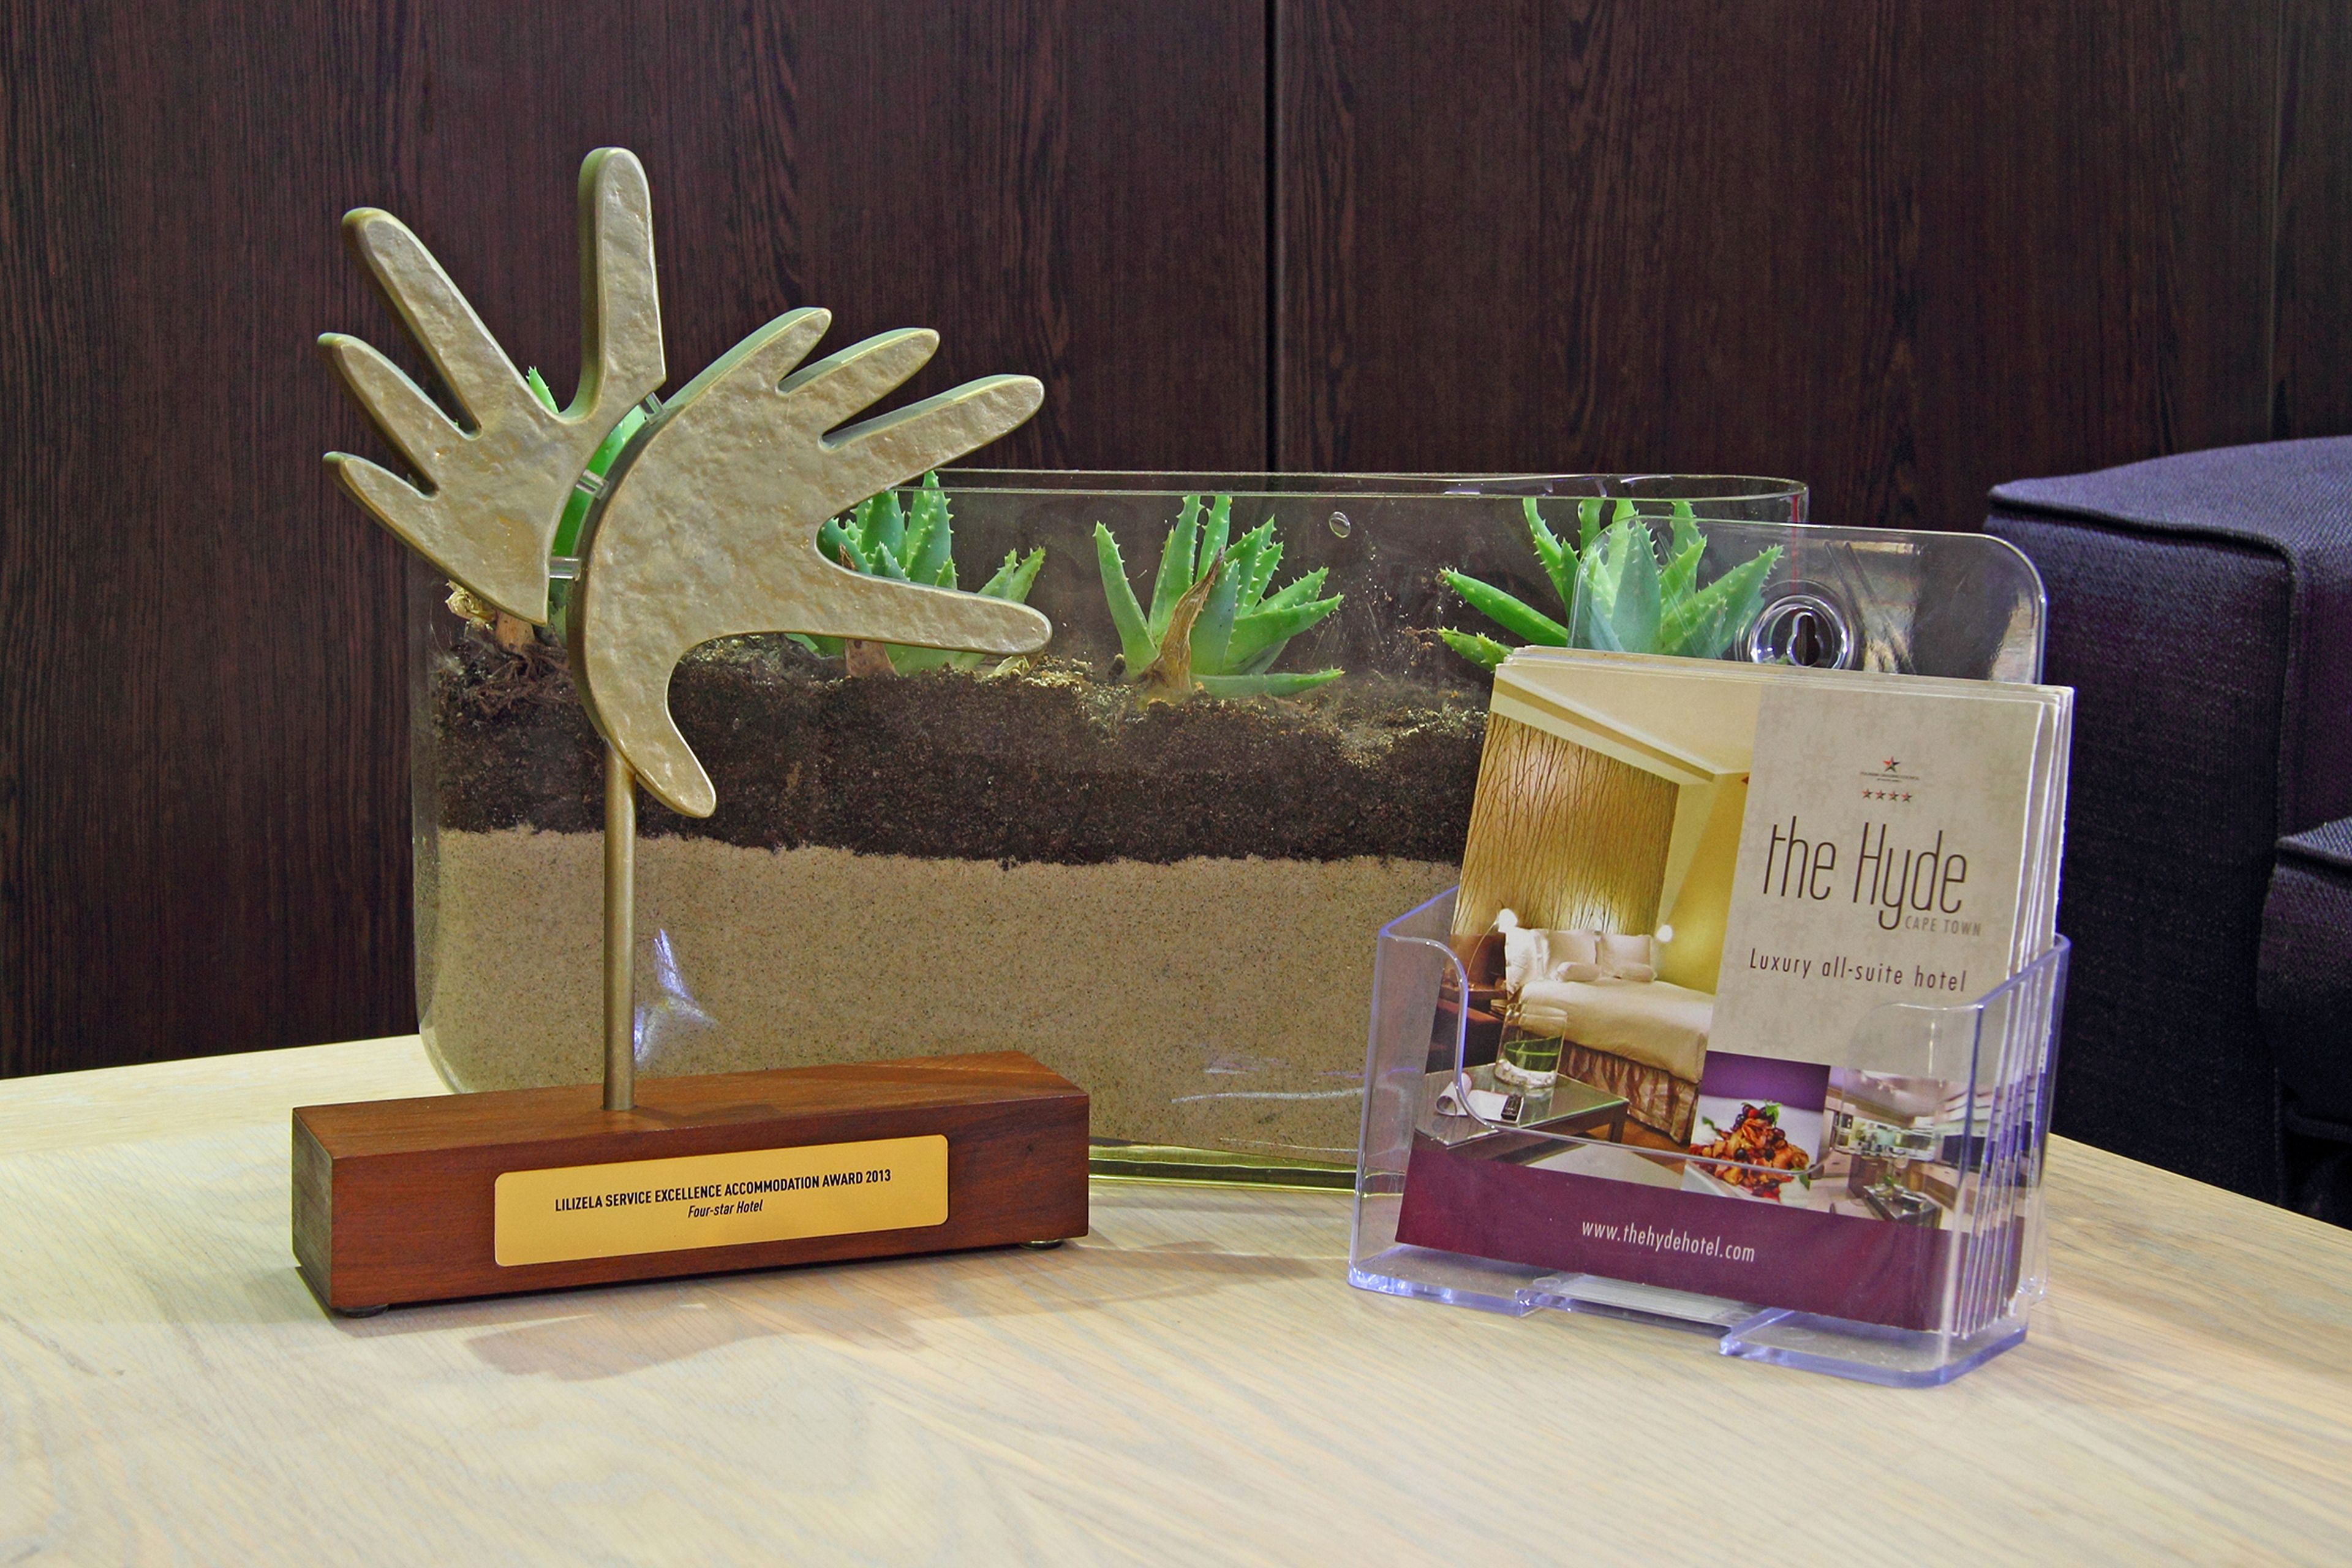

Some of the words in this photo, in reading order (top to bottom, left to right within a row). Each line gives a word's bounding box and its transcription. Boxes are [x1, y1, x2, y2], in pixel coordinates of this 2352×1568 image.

[1763, 816, 1837, 900] the
[1853, 822, 1967, 930] Hyde
[1905, 916, 1936, 932] CAPE
[1943, 919, 1982, 936] TOWN
[1750, 948, 1812, 980] Luxury
[1822, 956, 1903, 985] all-suite
[1914, 965, 1967, 992] hotel
[555, 1195, 603, 1212] LILIZELA
[605, 1191, 652, 1207] SERVICE
[655, 1185, 722, 1202] EXCELLENCE
[724, 1175, 820, 1196] ACCOMMODATION
[822, 1172, 863, 1188] AWARD
[865, 1169, 891, 1183] 2013
[688, 1204, 734, 1218] Four-star
[736, 1199, 763, 1214] Hotel
[1581, 1221, 1755, 1262] www.thehydehotel.com
